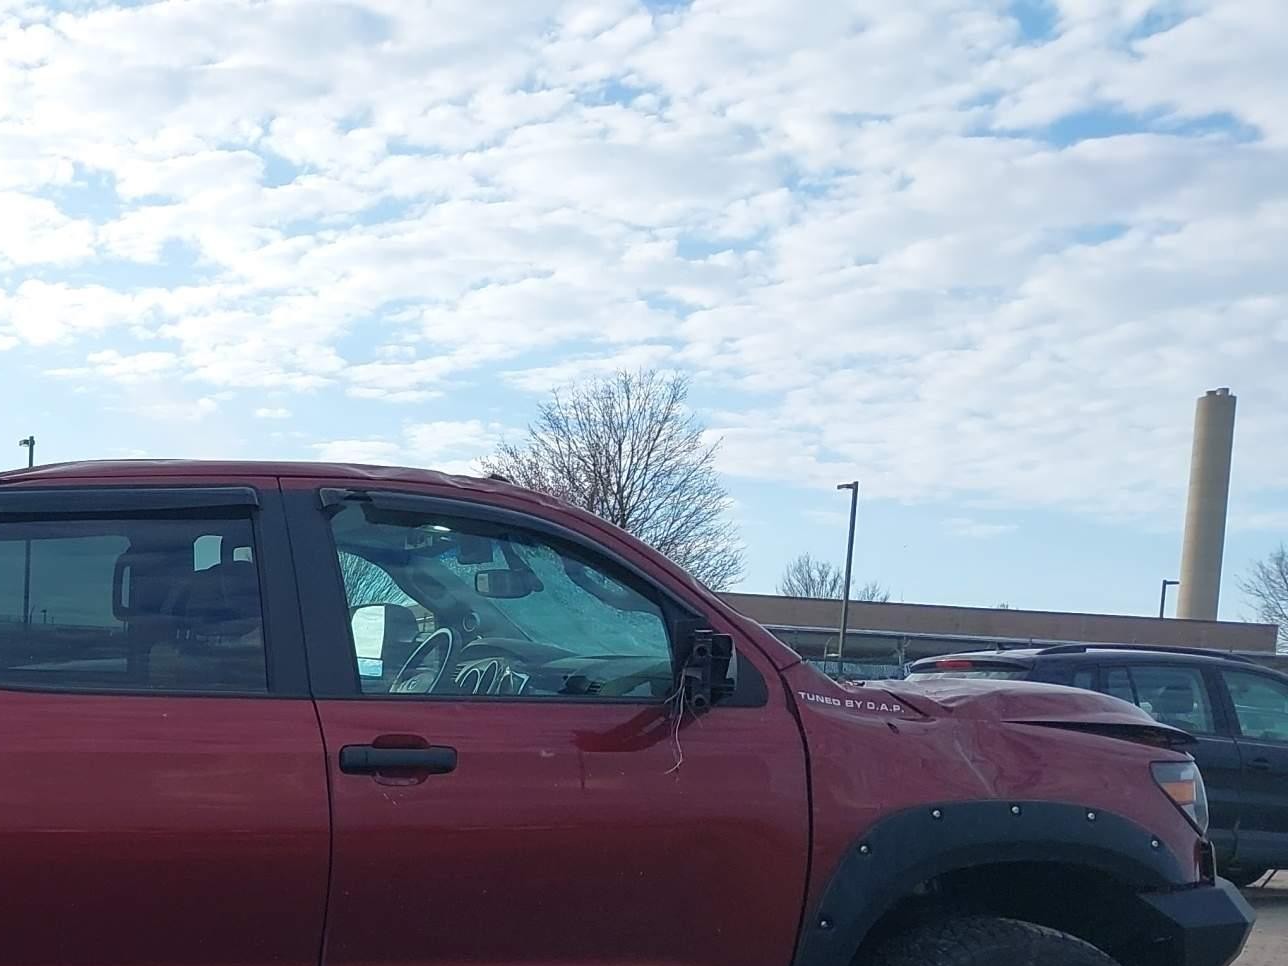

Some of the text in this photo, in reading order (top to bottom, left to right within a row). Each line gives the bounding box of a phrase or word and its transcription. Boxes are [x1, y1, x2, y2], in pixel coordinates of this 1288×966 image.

[798, 691, 905, 713] TUNED BY D.A.P.
